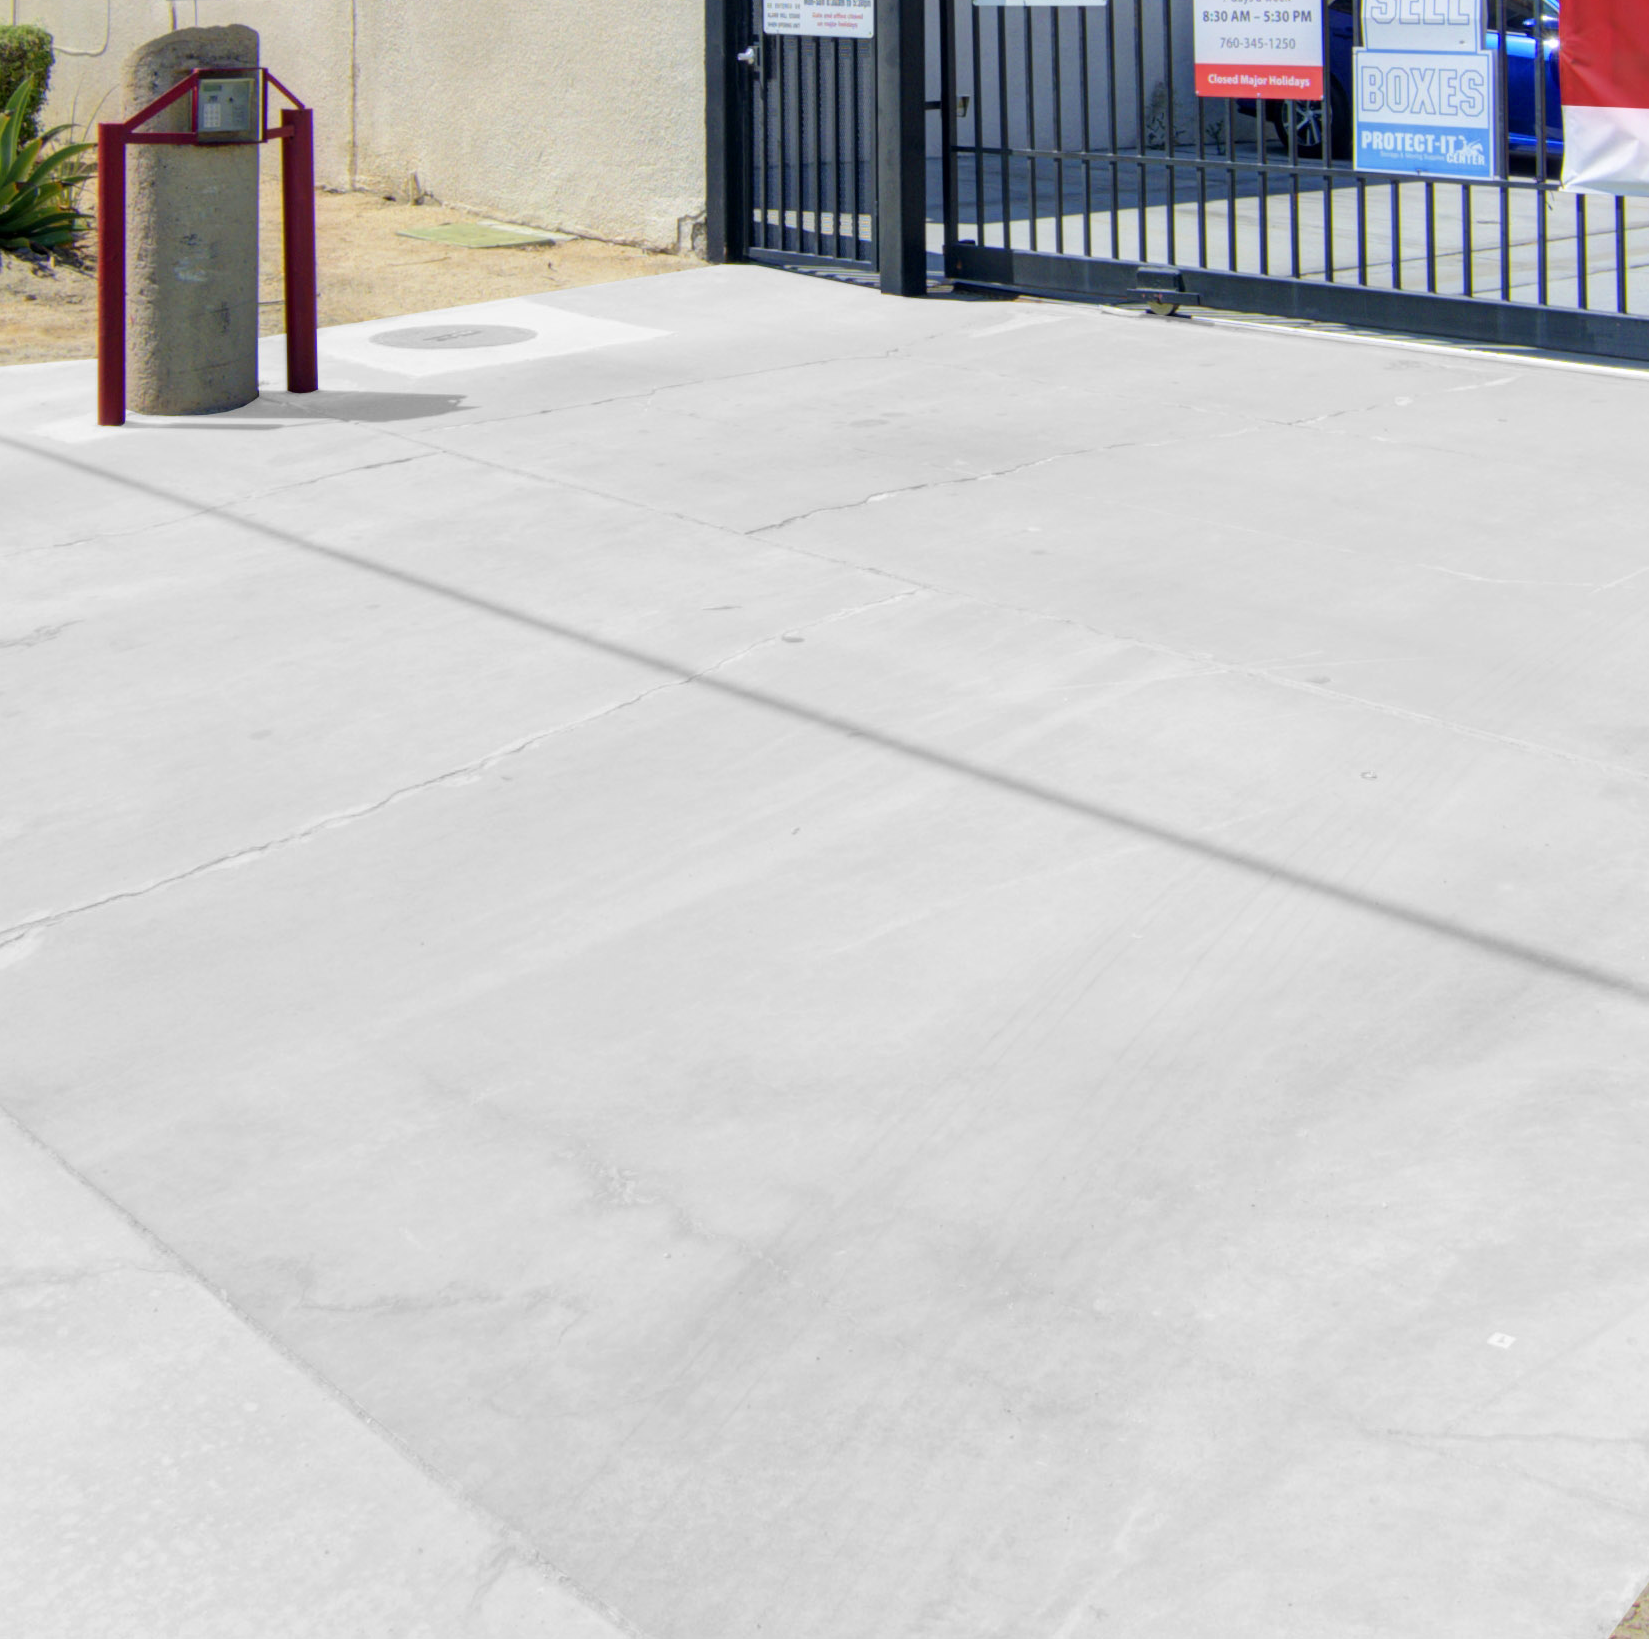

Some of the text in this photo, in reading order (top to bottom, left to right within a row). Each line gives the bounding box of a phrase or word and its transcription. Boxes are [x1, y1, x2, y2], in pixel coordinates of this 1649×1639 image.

[1202, 10, 1228, 23] 8:30
[1231, 10, 1251, 23] AM
[1264, 10, 1290, 23] 5:30
[1293, 10, 1312, 23] PM
[1219, 37, 1296, 50] 760-345-1250
[1208, 74, 1311, 89] Closed Major Holidays
[1361, 66, 1485, 117] BOXES
[1361, 130, 1457, 154] PROTECT-IT
[1446, 152, 1485, 166] CENTER
